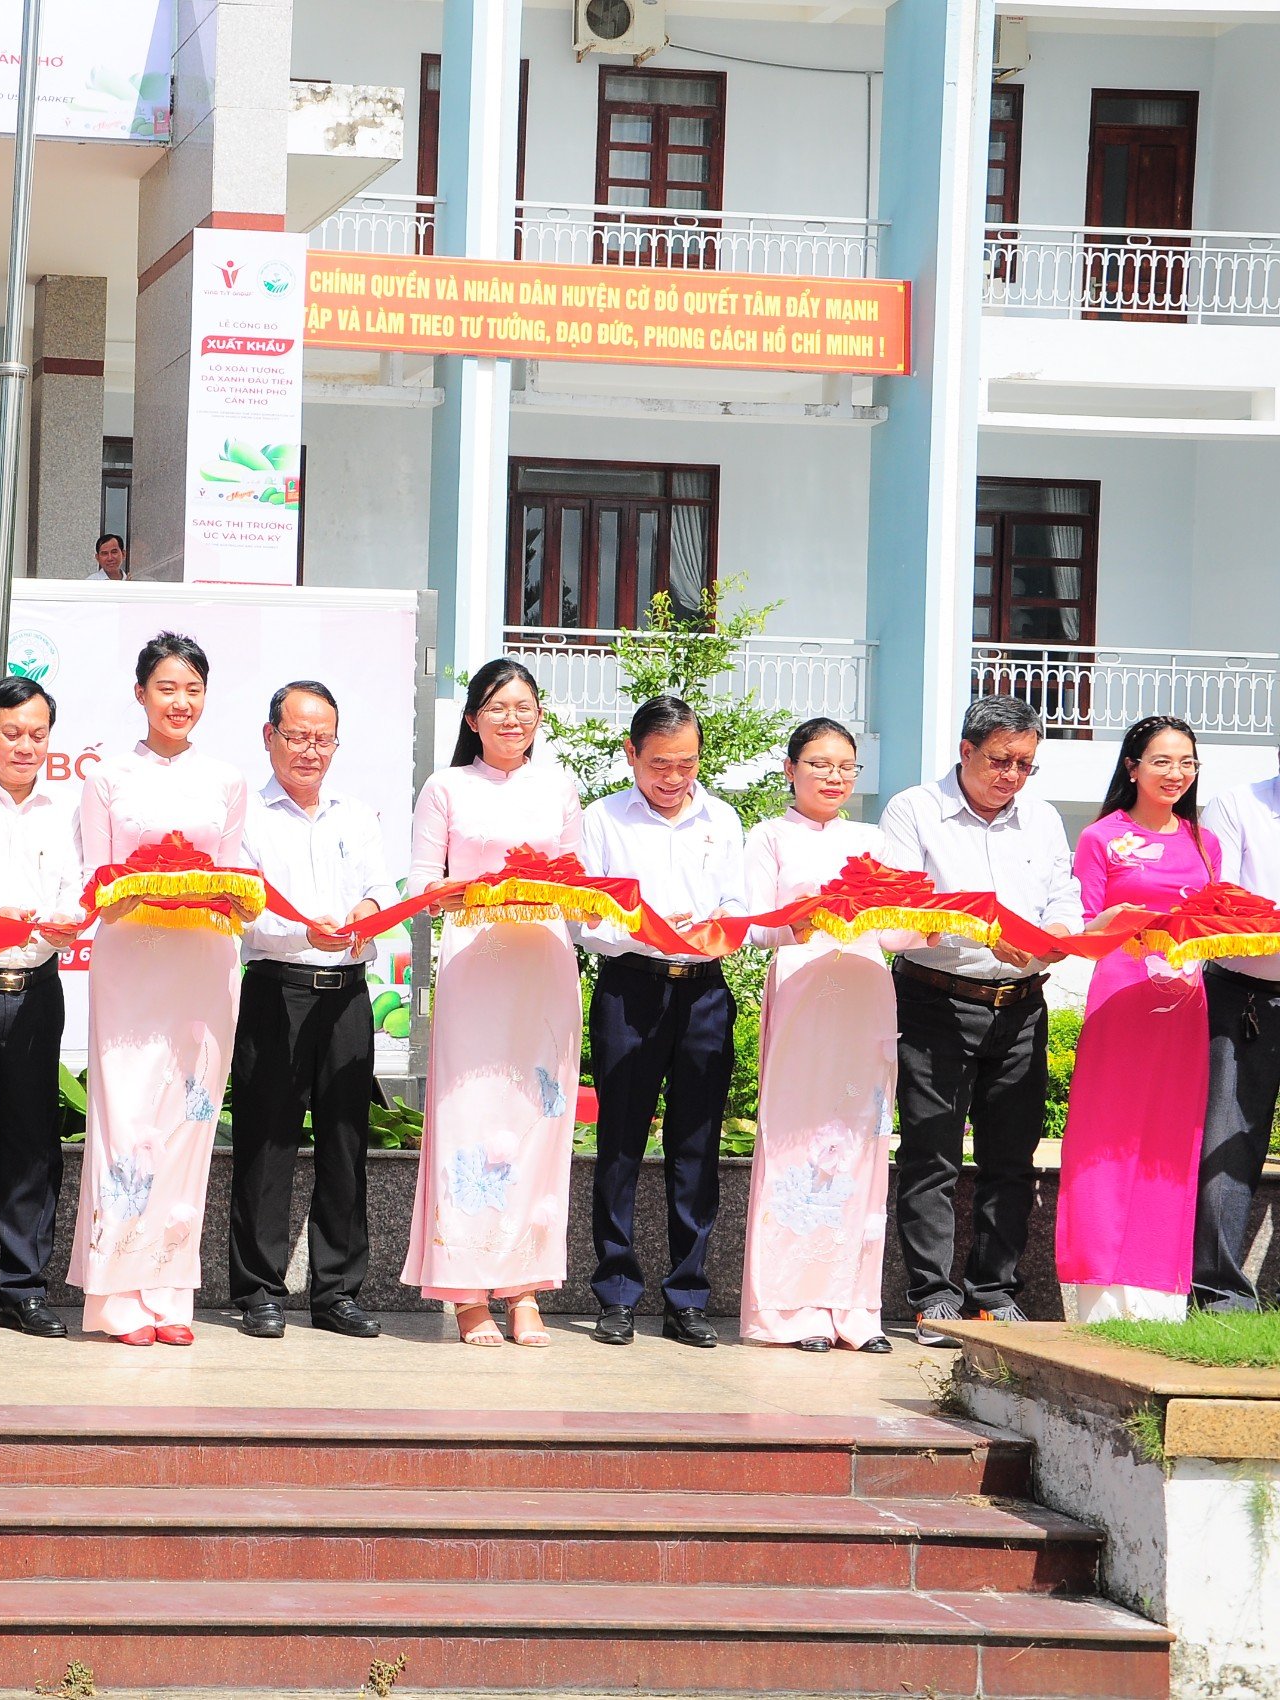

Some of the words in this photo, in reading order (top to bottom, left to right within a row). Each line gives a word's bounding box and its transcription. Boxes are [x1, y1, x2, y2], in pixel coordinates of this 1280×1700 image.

[38, 55, 64, 67] HƠ
[310, 267, 366, 295] CHÍNH
[371, 270, 430, 299] QUYỀN
[435, 275, 458, 301] VÀ
[464, 277, 514, 303] NHÂN
[519, 279, 557, 306] DÂN
[562, 282, 620, 312] HUYỆN
[626, 284, 651, 311] CỜ
[654, 284, 678, 312] ĐỎ
[684, 287, 739, 315] QUYẾT
[743, 291, 781, 317] TÂM
[786, 288, 821, 319] ĐẨY
[826, 298, 878, 325] MẠNH
[337, 305, 360, 331] VÀ
[366, 307, 404, 334] LÀM
[410, 313, 454, 337] THEO
[460, 315, 484, 338] TƯ
[487, 312, 551, 344] TƯỞNG,
[556, 321, 592, 348] ĐẠO
[597, 319, 638, 349] ĐỨC,
[644, 326, 705, 349] PHONG
[710, 325, 757, 352] CÁCH
[763, 325, 786, 353] HỒ
[792, 329, 821, 354] CHÍ
[826, 334, 873, 357] MINH
[880, 337, 884, 357] !
[206, 337, 243, 350] XUẤT
[246, 339, 286, 353] KHẨU
[218, 375, 245, 384] XANH
[192, 519, 222, 528] SANG
[240, 533, 264, 542] HOA
[46, 742, 104, 781] BỐ
[79, 947, 91, 963] 6
